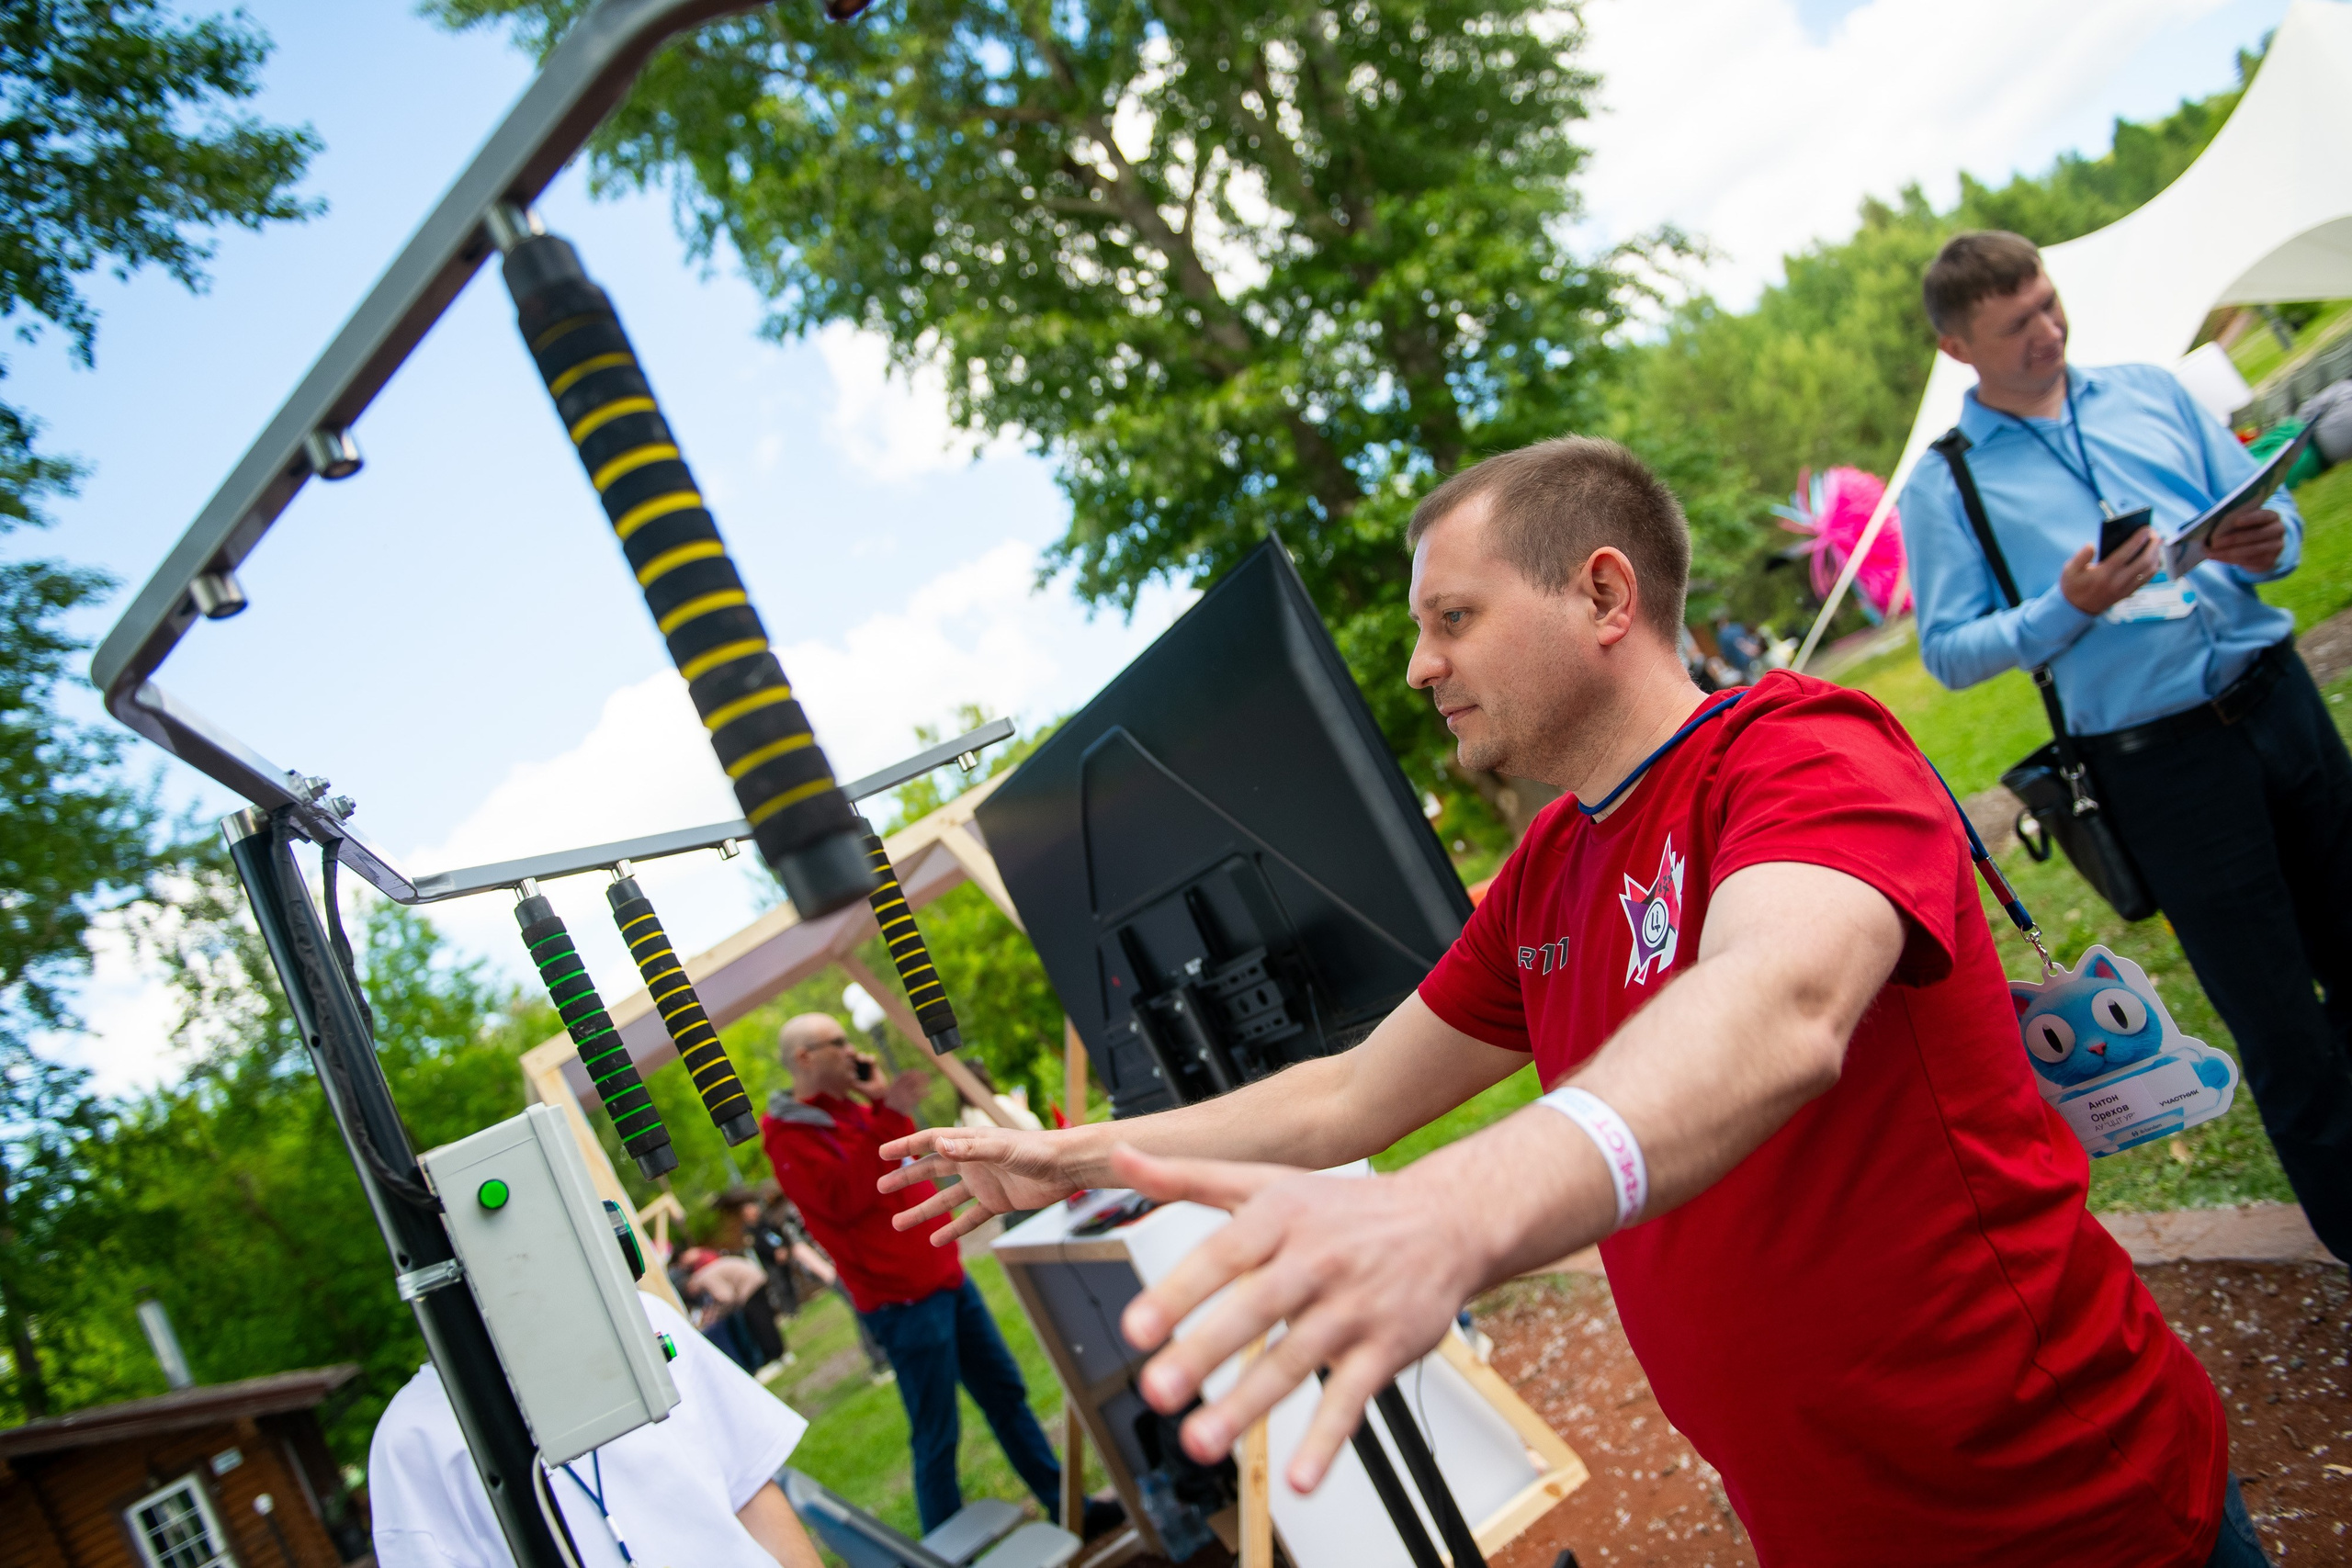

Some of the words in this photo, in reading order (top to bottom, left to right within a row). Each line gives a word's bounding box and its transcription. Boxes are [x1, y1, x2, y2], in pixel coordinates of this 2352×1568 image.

[2088, 1094, 2120, 1111] Антон
[2159, 1089, 2199, 1107] УЧАСТНИК
[2090, 1104, 2130, 1122] Орехов
